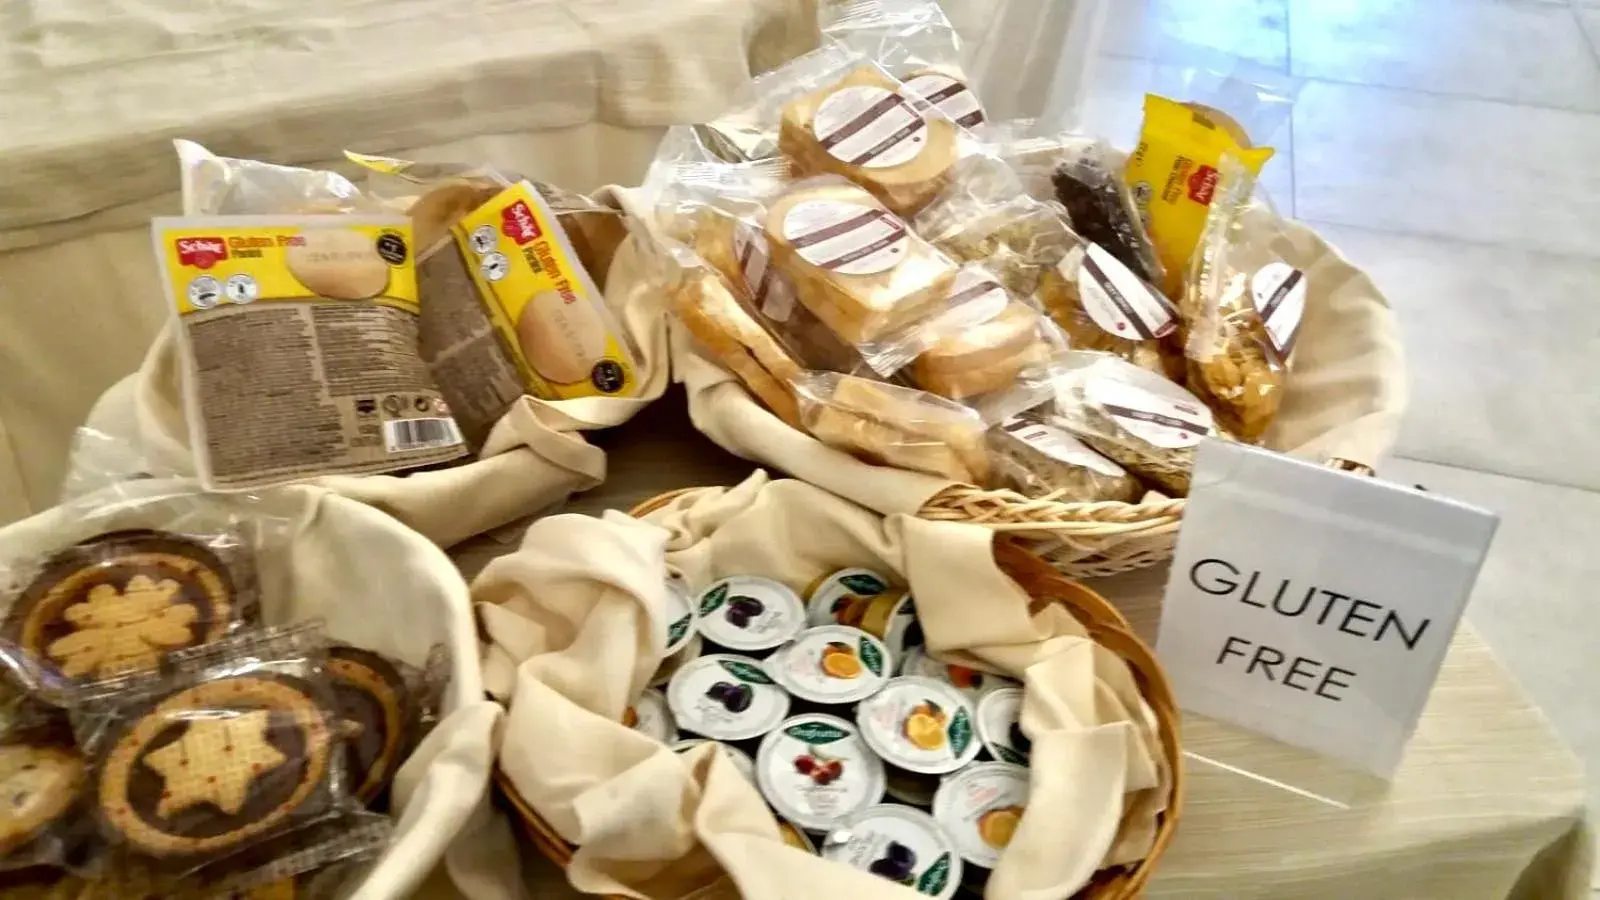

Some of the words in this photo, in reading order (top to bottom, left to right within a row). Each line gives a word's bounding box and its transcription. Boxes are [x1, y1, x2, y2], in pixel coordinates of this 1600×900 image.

[228, 235, 275, 249] Gluten
[276, 234, 306, 247] Free
[535, 241, 562, 279] Gluten
[555, 279, 577, 305] Free
[1189, 558, 1431, 651] GLUTEN
[1216, 636, 1357, 701] FREE
